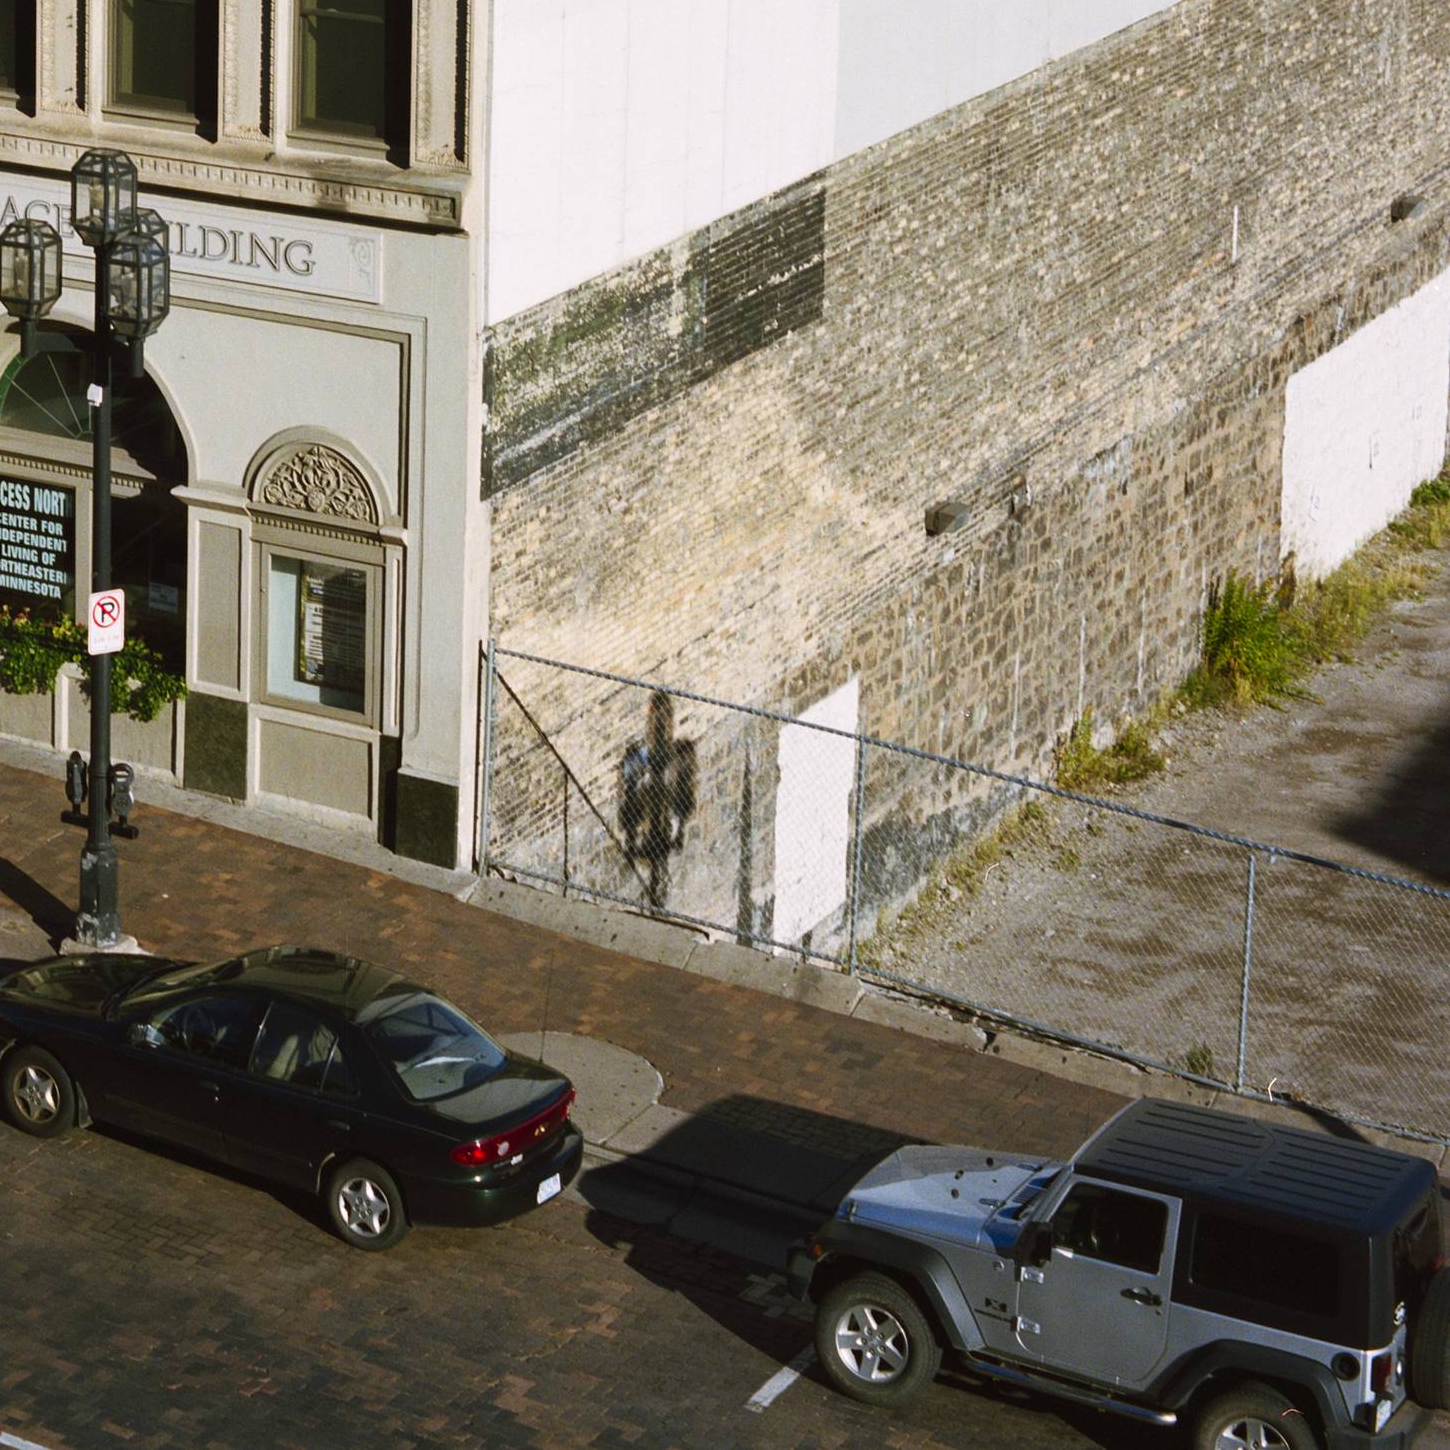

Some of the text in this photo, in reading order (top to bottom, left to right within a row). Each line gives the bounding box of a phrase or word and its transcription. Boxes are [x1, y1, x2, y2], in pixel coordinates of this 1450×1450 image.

[166, 221, 317, 286] LDING
[41, 520, 63, 536] FOR
[2, 543, 56, 566] LIVING OF
